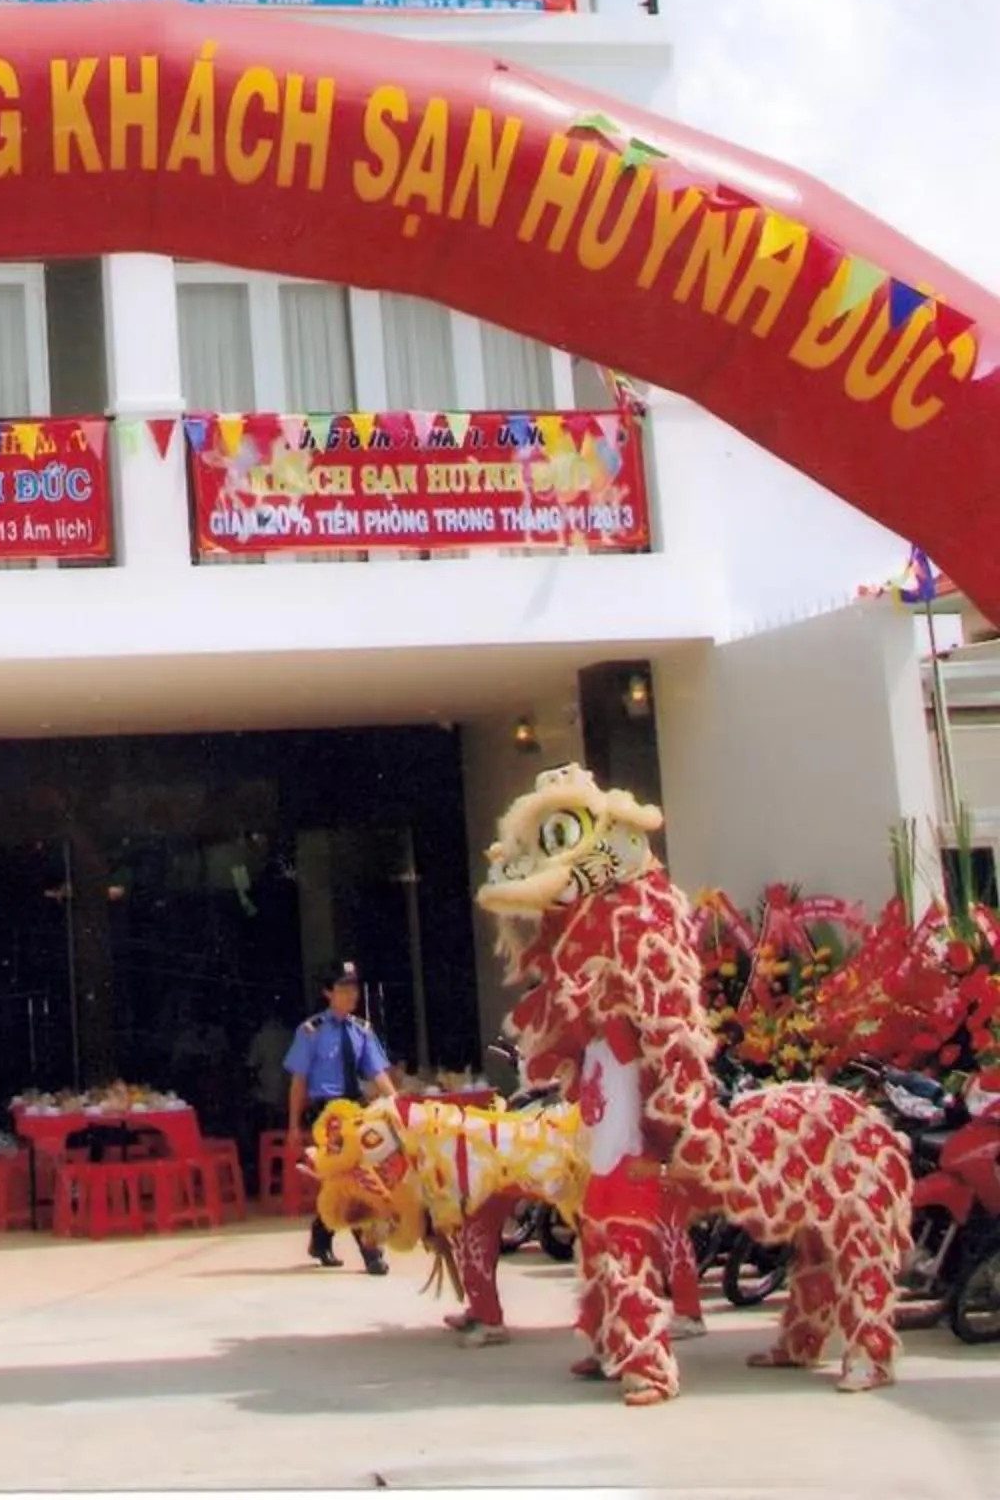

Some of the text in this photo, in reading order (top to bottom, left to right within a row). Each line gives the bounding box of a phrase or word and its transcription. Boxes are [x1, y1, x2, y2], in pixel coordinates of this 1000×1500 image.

[50, 39, 334, 191] KHÁCH
[353, 85, 523, 238] SẠN
[14, 460, 93, 504] ĐỨC
[360, 464, 419, 502] SẠN
[425, 455, 523, 494] HUỲNH
[22, 514, 51, 541] Âm
[55, 517, 93, 545] lịch)
[364, 503, 428, 533] PHÒNG
[433, 507, 495, 532] TRONG
